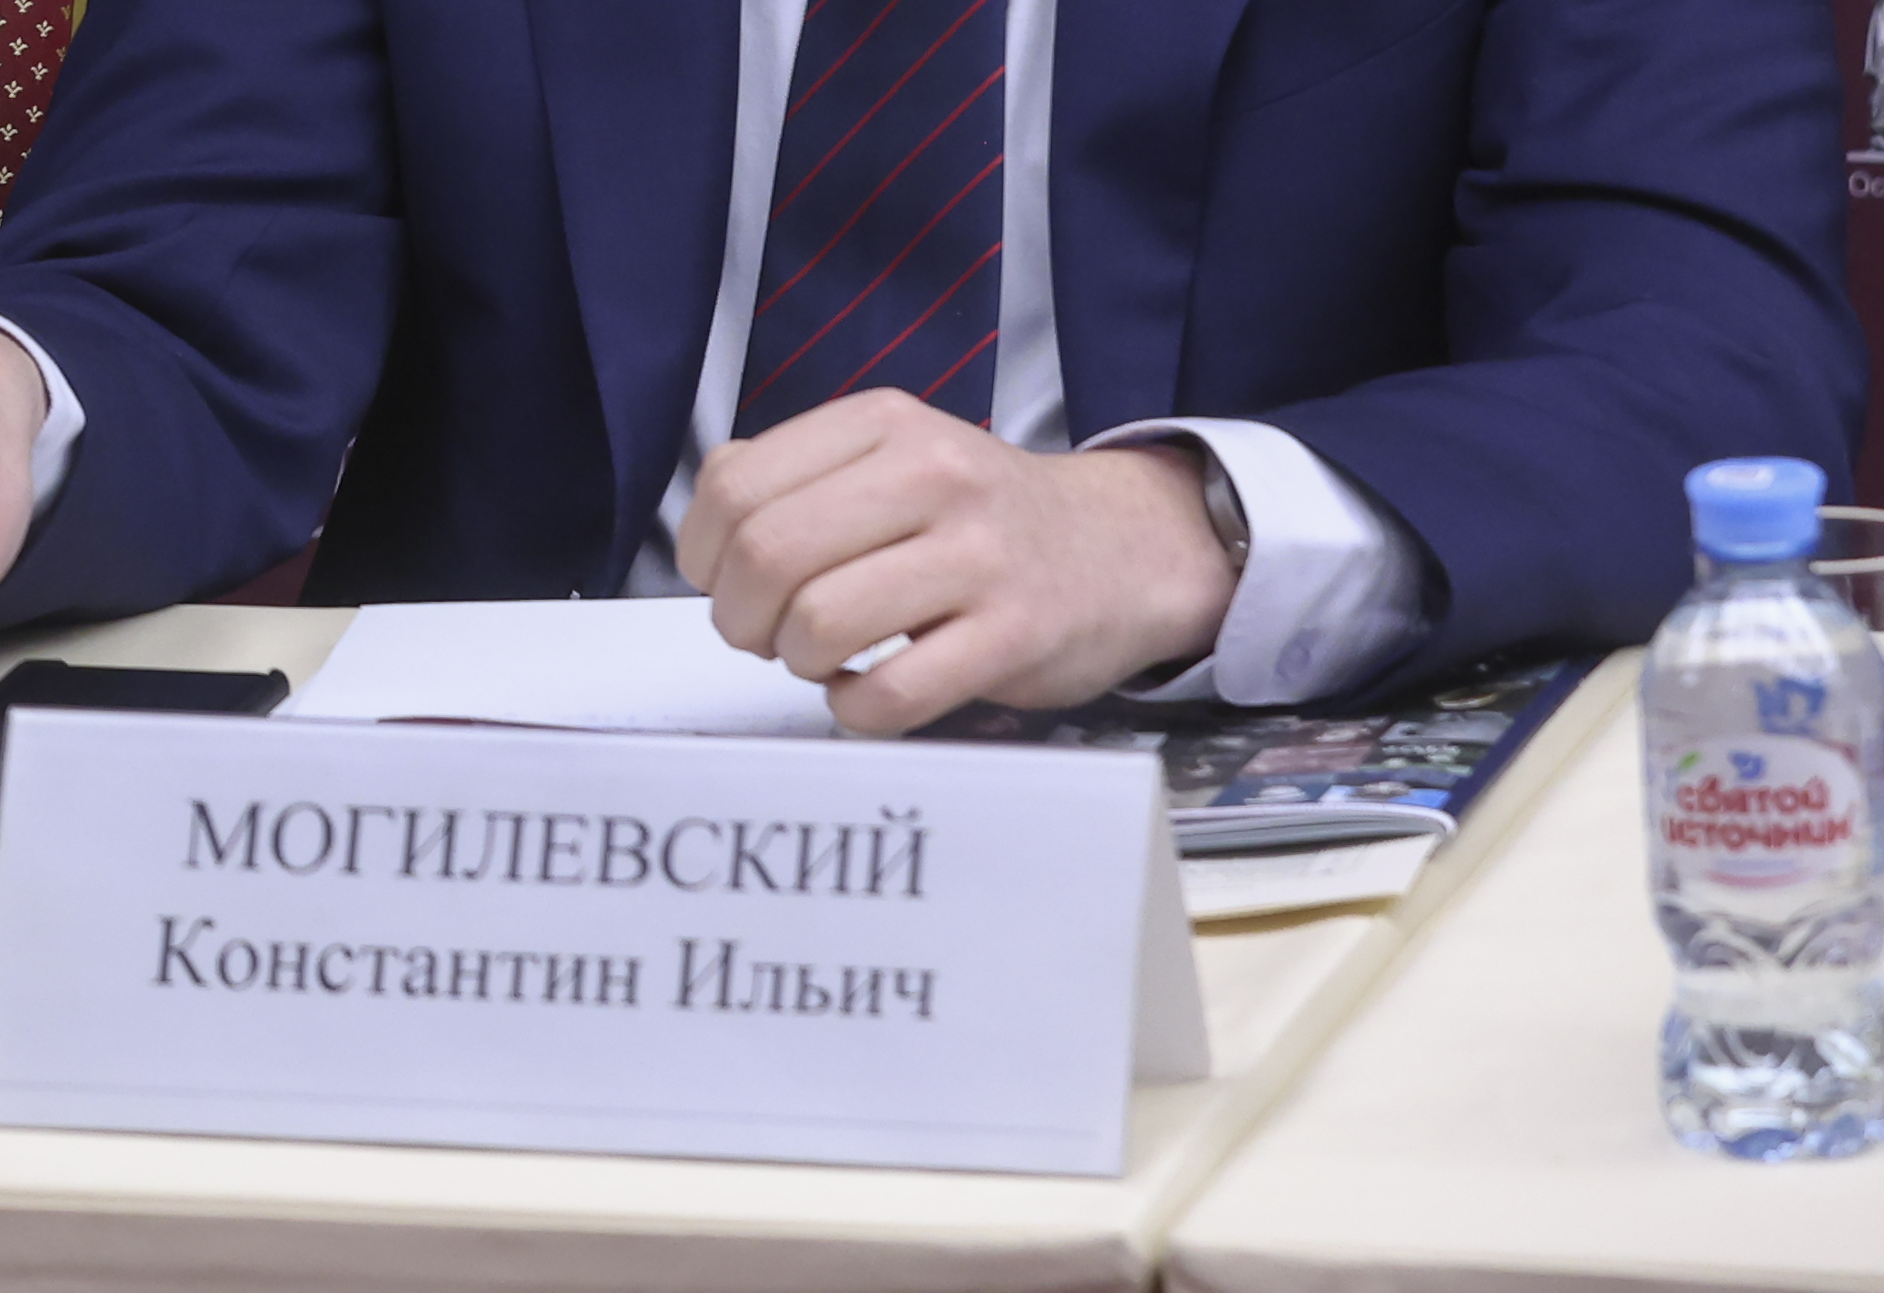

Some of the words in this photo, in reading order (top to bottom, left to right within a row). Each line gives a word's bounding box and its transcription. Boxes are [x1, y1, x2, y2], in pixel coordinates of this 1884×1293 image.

[180, 799, 931, 899] МОГИЛЕВСКИЙ
[151, 917, 641, 1007] Константин
[674, 939, 937, 1020] Ильич
